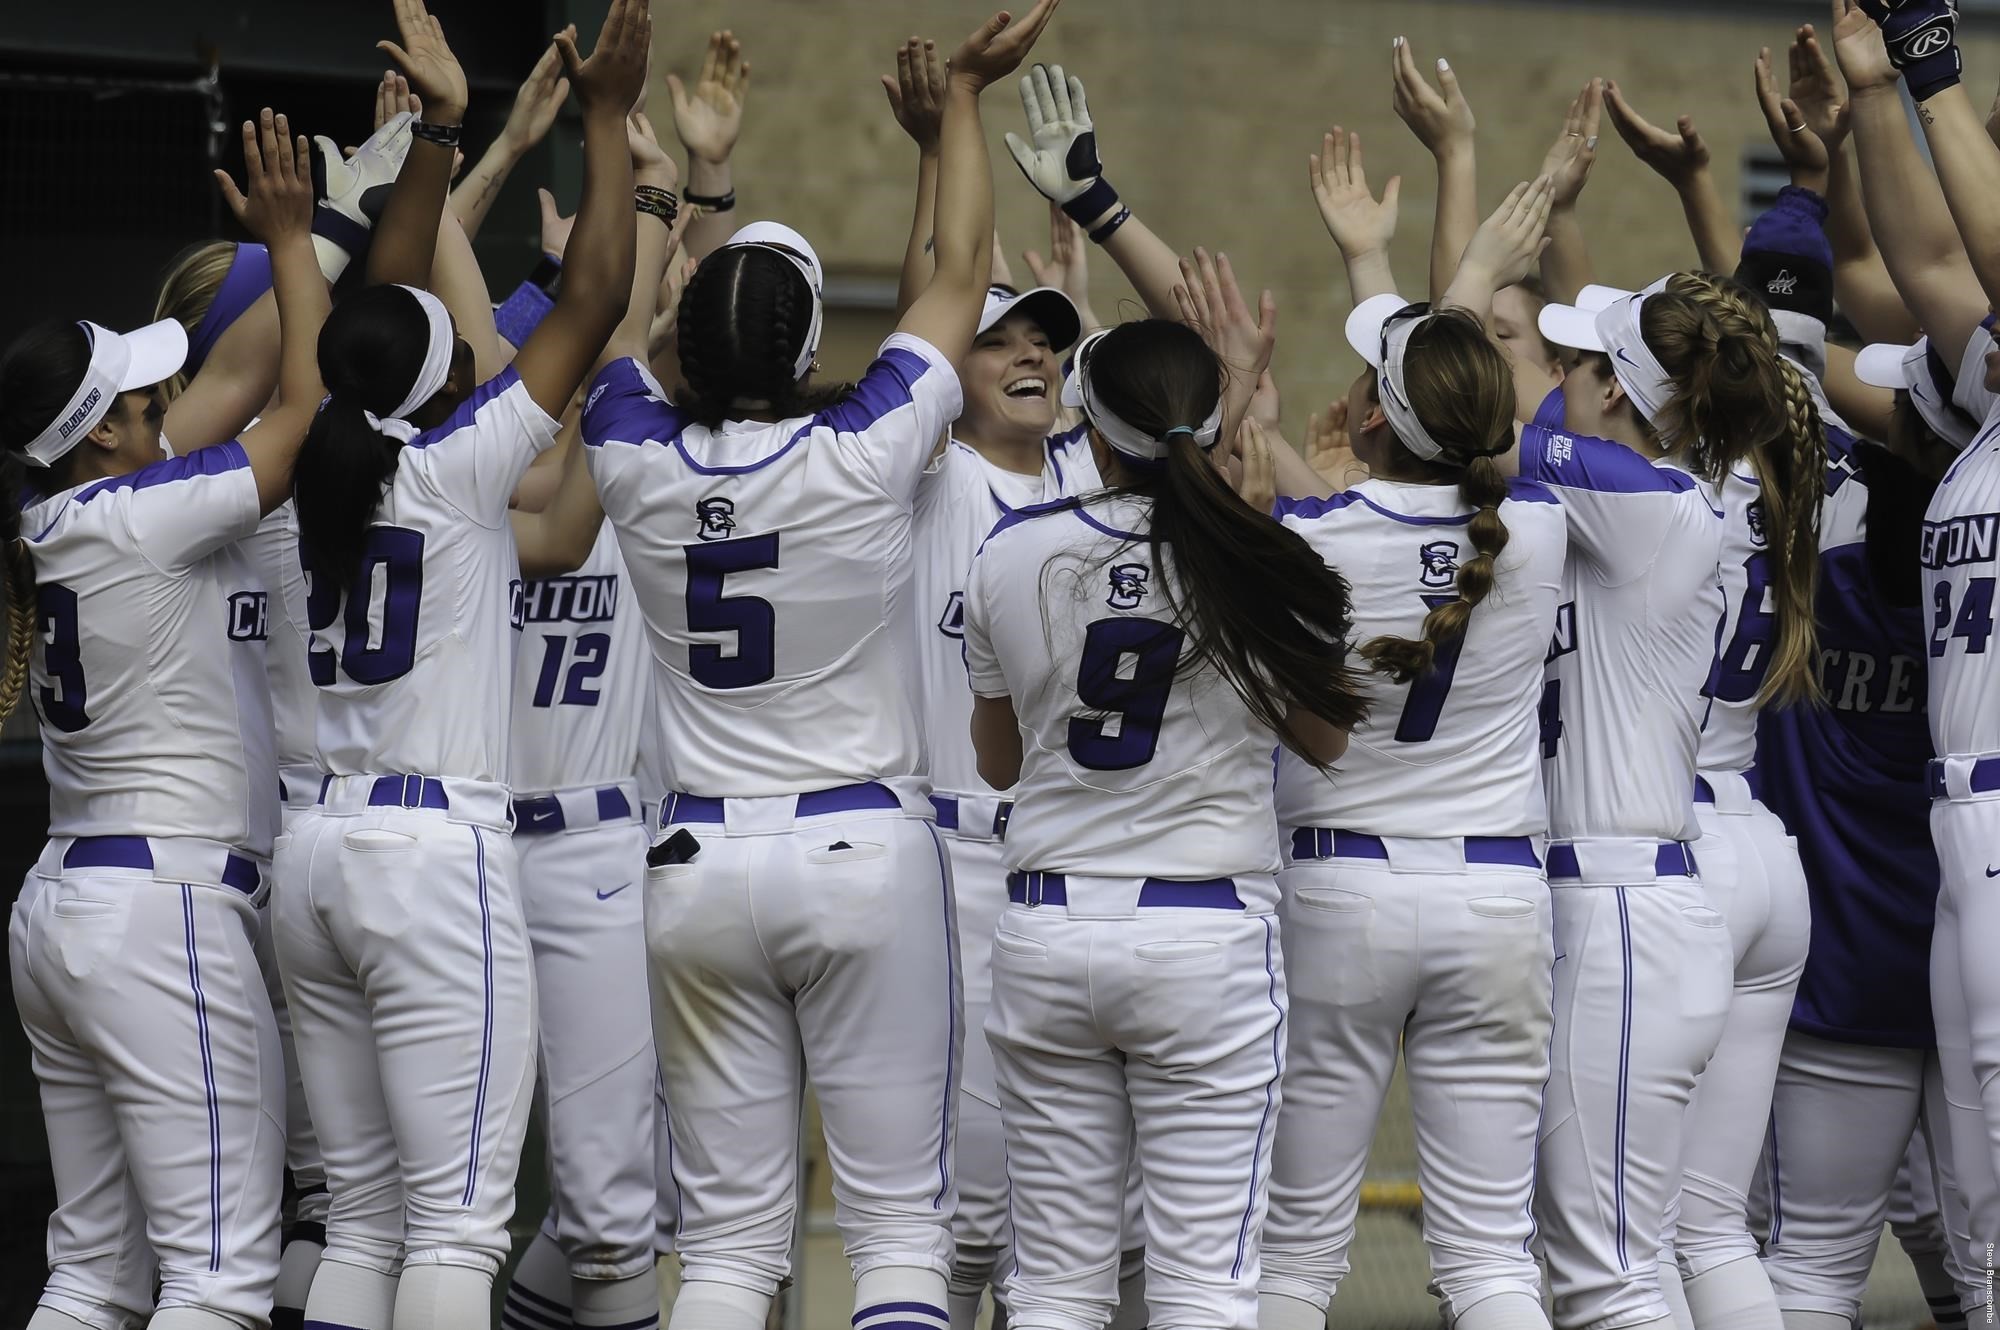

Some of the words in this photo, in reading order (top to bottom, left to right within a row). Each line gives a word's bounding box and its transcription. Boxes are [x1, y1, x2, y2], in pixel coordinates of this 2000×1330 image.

[1553, 434, 1564, 467] EAST
[1562, 437, 1573, 461] BIG
[683, 531, 780, 689] 5
[1930, 577, 1997, 658] 24
[533, 632, 611, 708] 12
[1067, 616, 1187, 771] 9
[1820, 648, 1928, 713] CRE
